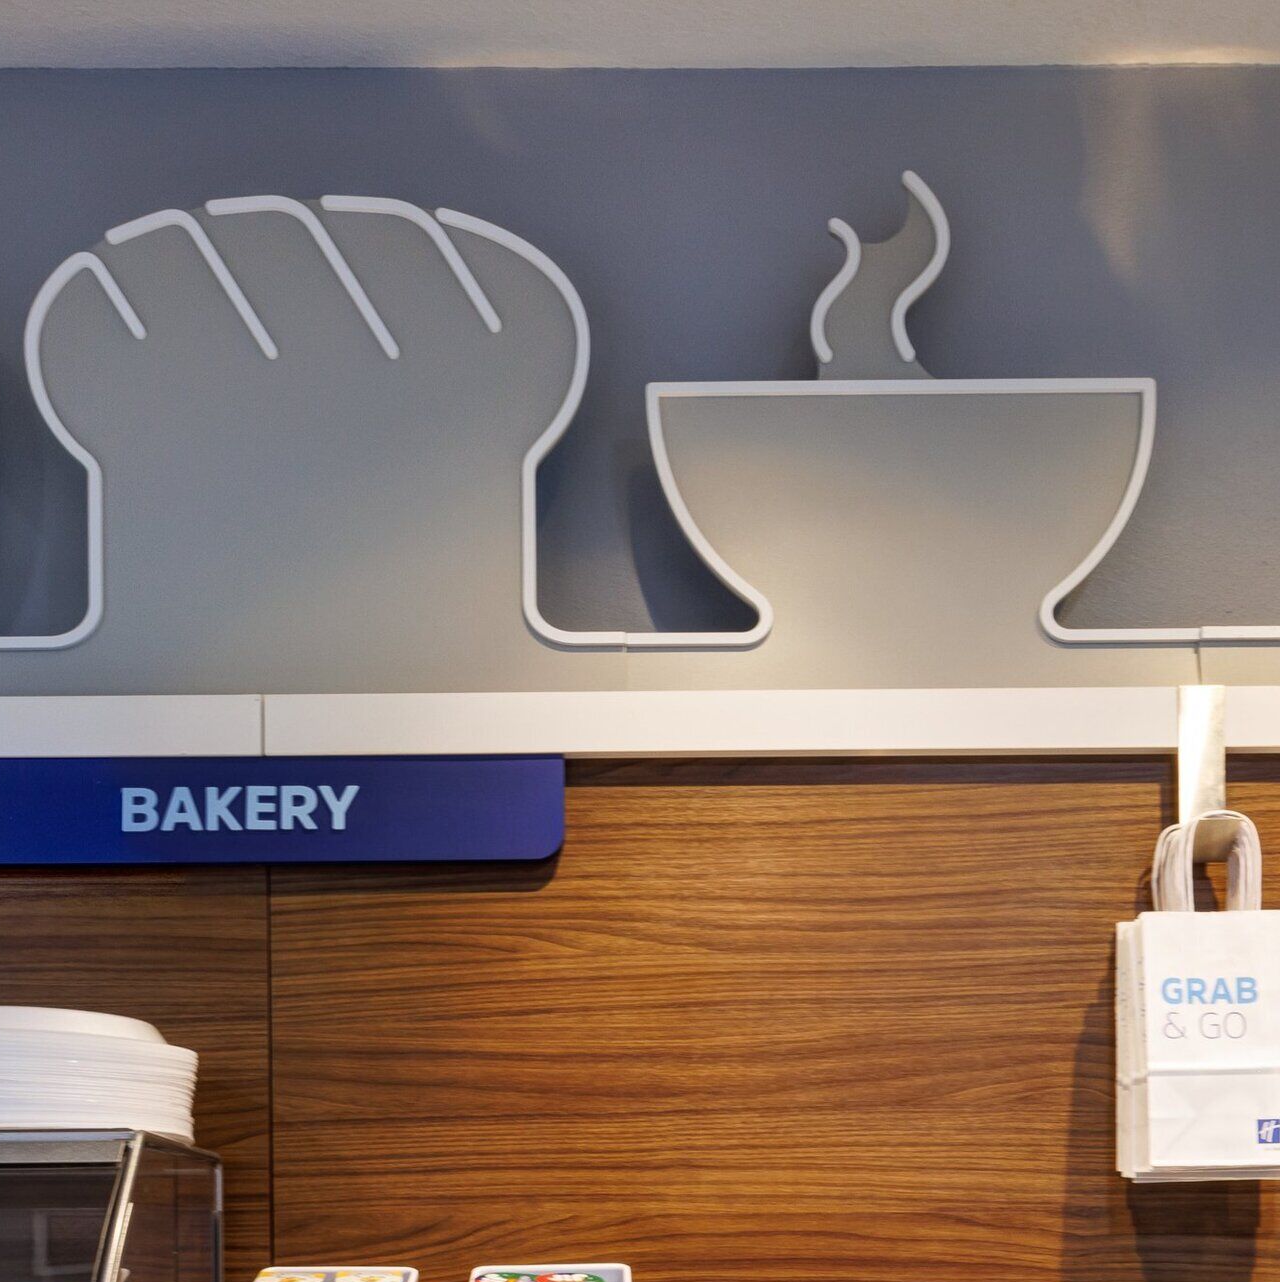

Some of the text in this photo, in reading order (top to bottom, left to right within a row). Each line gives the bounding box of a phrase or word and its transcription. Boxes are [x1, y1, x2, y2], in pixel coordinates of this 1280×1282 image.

[120, 784, 360, 832] BAKERY
[1161, 976, 1259, 1005] GRAB
[1163, 1011, 1248, 1040] & GO
